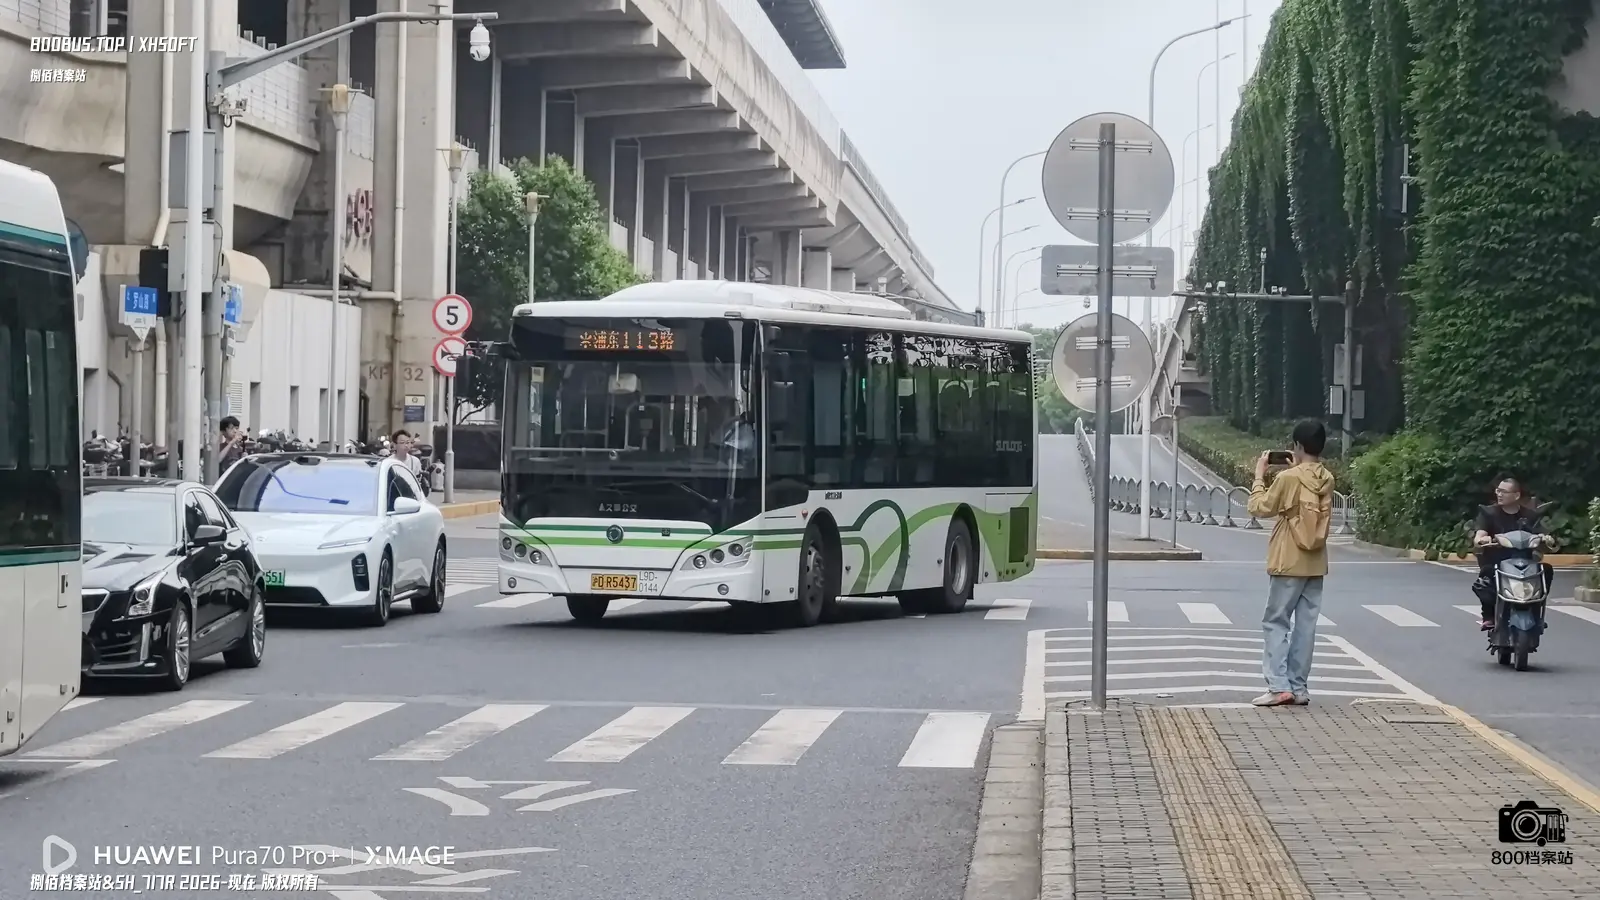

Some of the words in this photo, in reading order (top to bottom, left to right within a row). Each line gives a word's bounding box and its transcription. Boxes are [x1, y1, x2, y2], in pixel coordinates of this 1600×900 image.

[446, 306, 459, 325] 5
[404, 367, 424, 381] 32
[263, 570, 283, 584] 551
[639, 583, 658, 593] 0144
